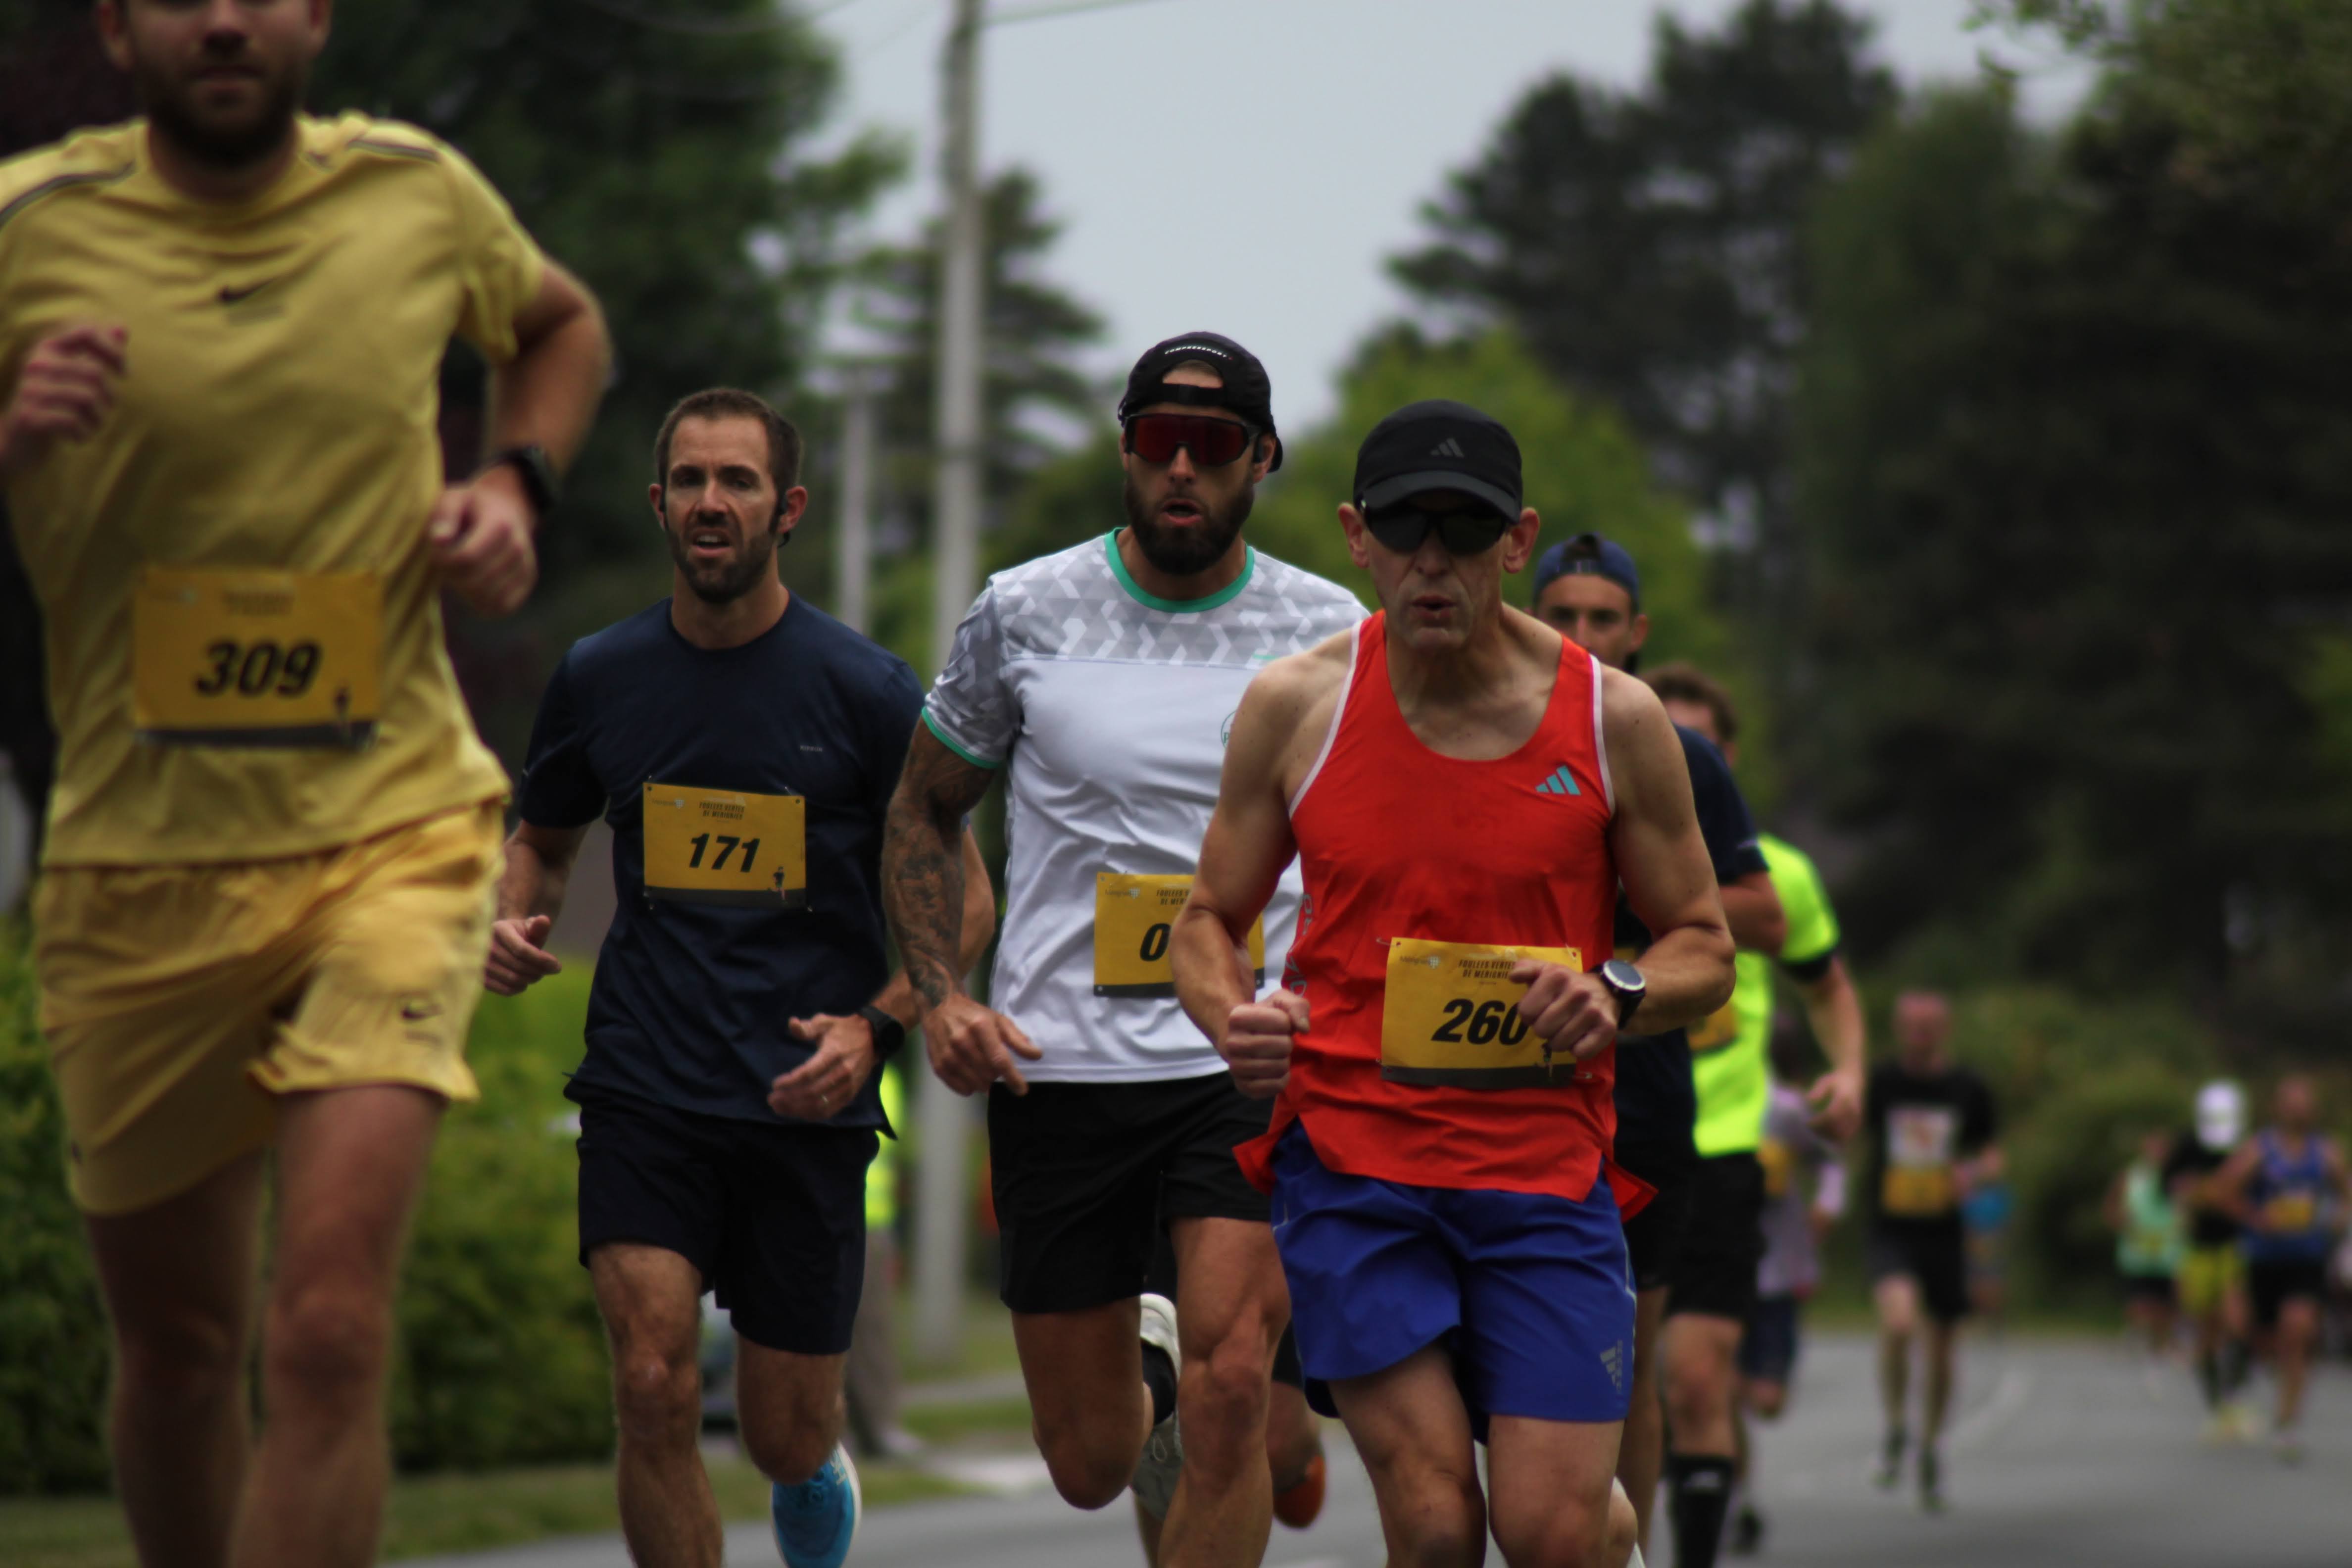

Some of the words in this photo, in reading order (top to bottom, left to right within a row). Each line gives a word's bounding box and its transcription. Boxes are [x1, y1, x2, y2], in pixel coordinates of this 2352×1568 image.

[195, 638, 322, 697] 309
[689, 833, 761, 873] 171
[1431, 998, 1529, 1046] 260
